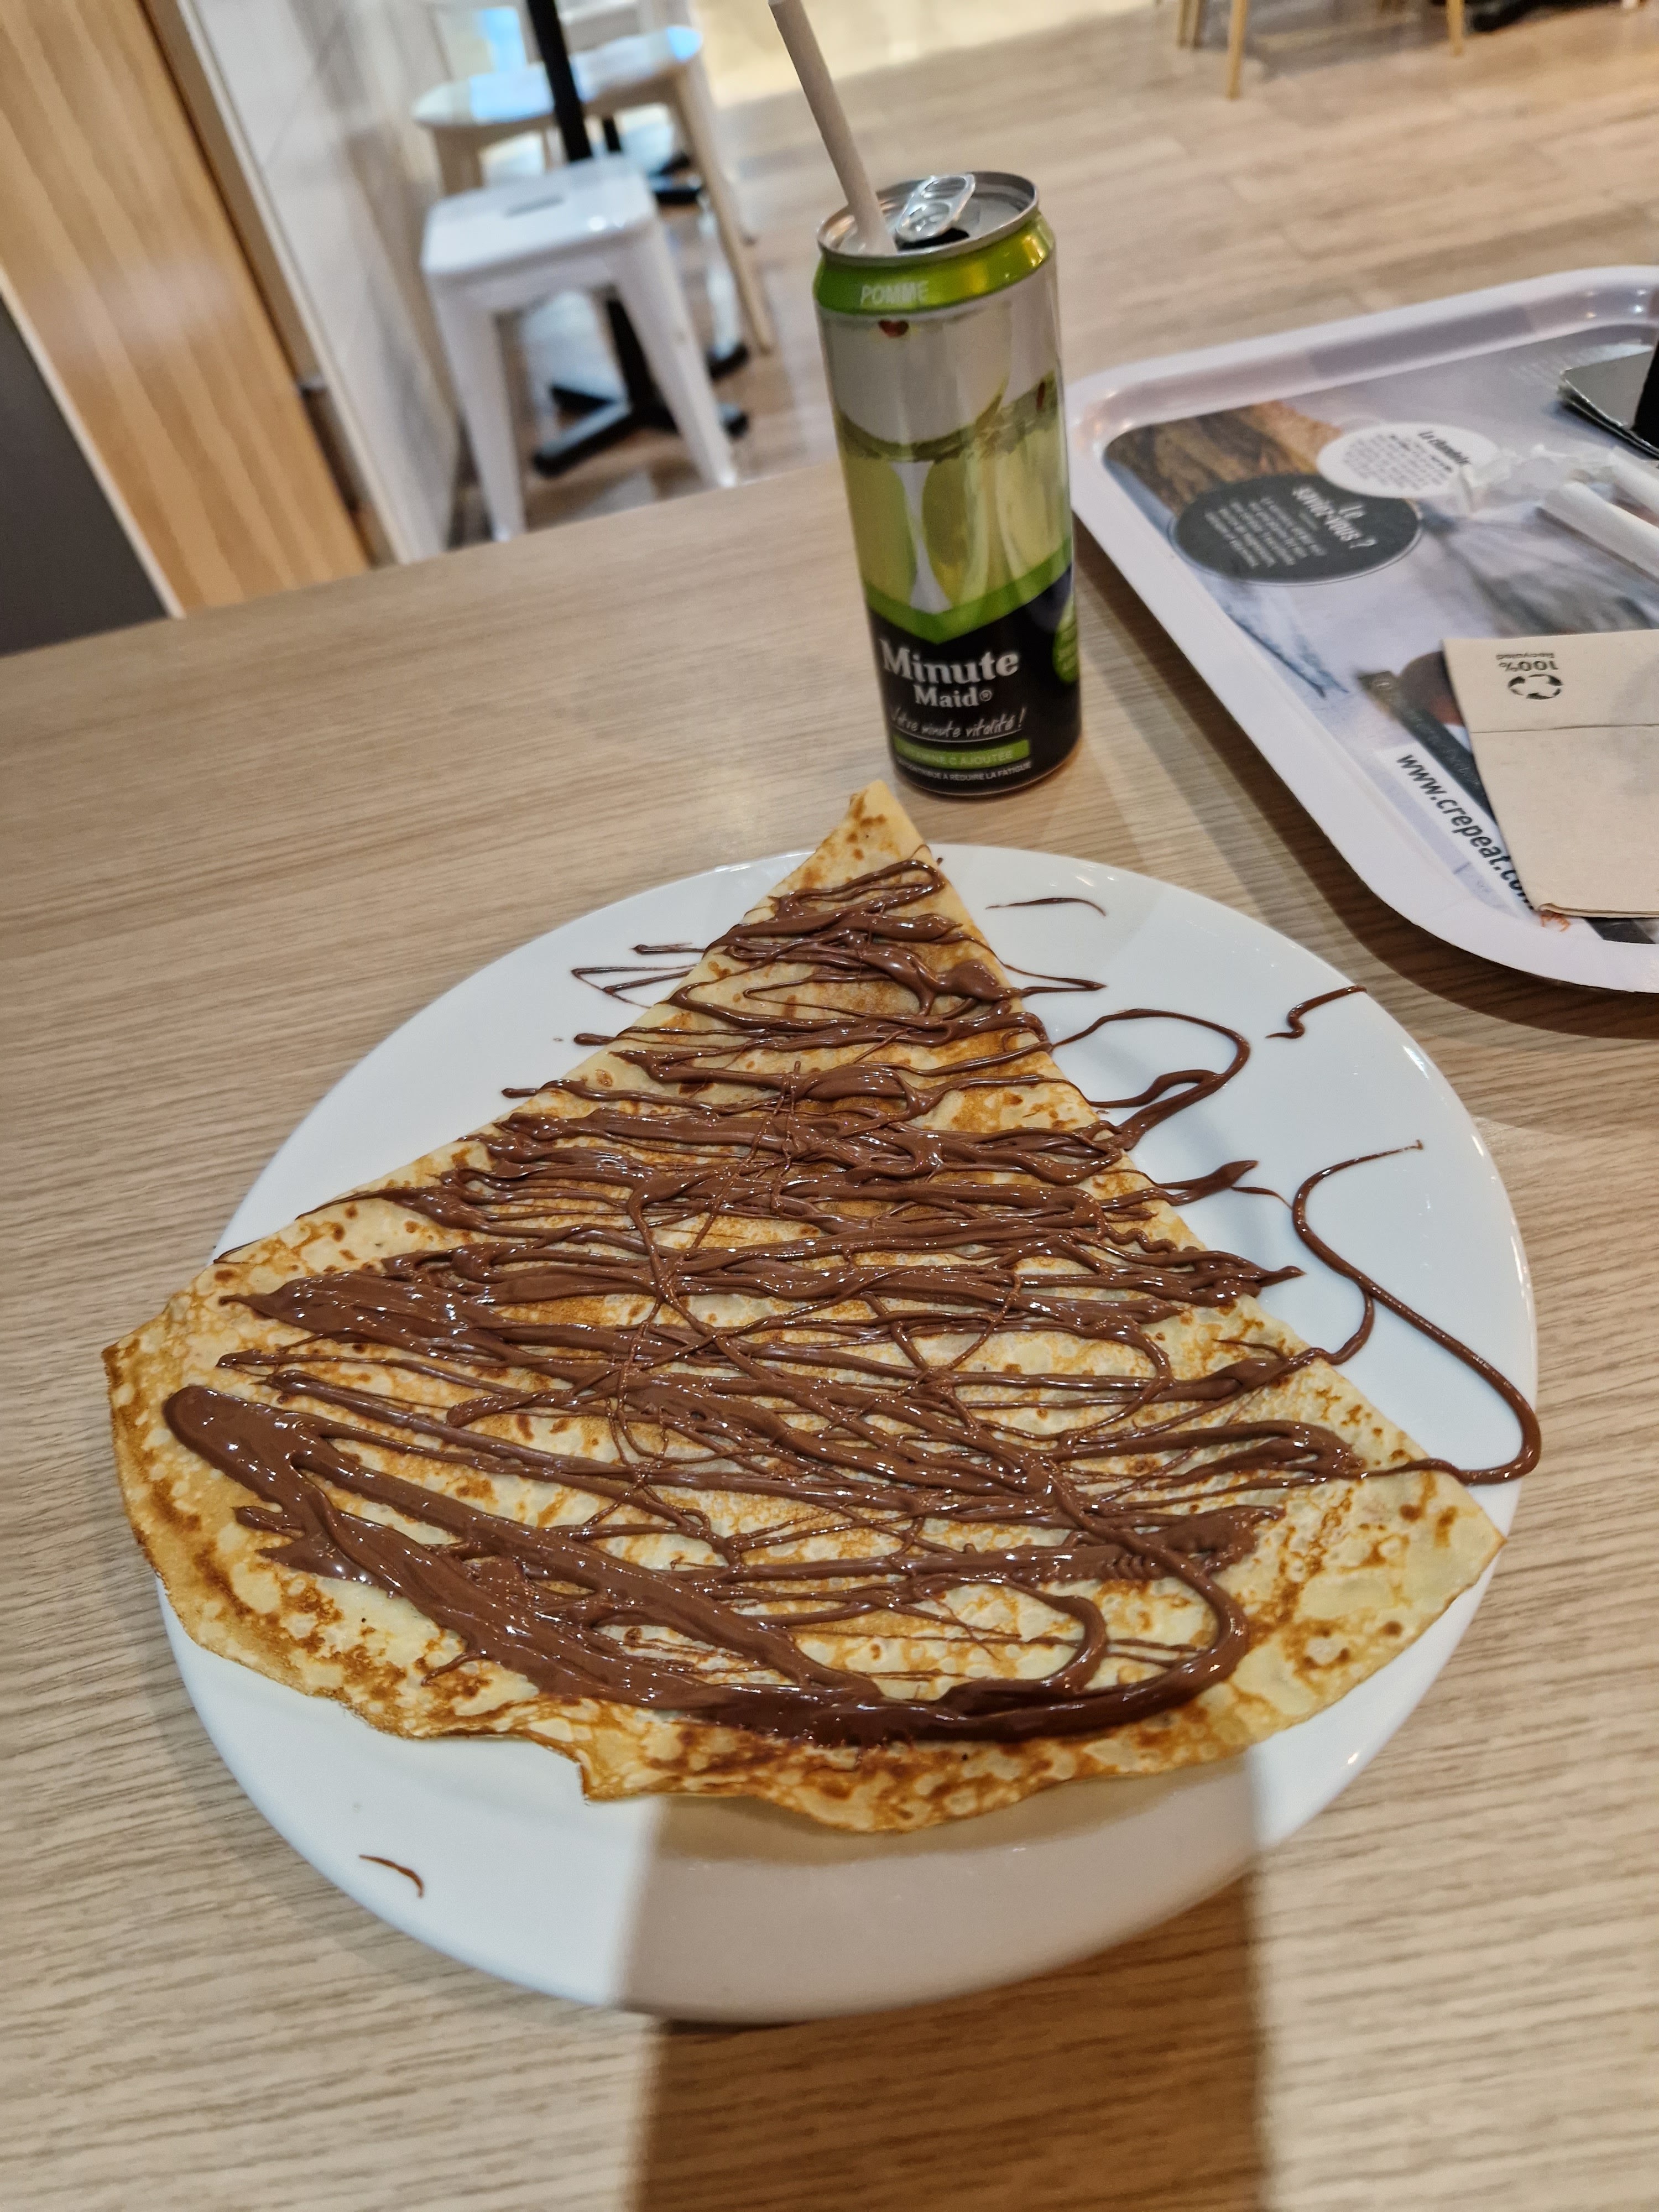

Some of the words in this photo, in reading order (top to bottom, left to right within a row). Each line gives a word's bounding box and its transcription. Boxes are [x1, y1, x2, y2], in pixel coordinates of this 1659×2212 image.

[860, 280, 929, 305] POMME
[879, 638, 1019, 684] Minute
[1499, 661, 1558, 672] 100%
